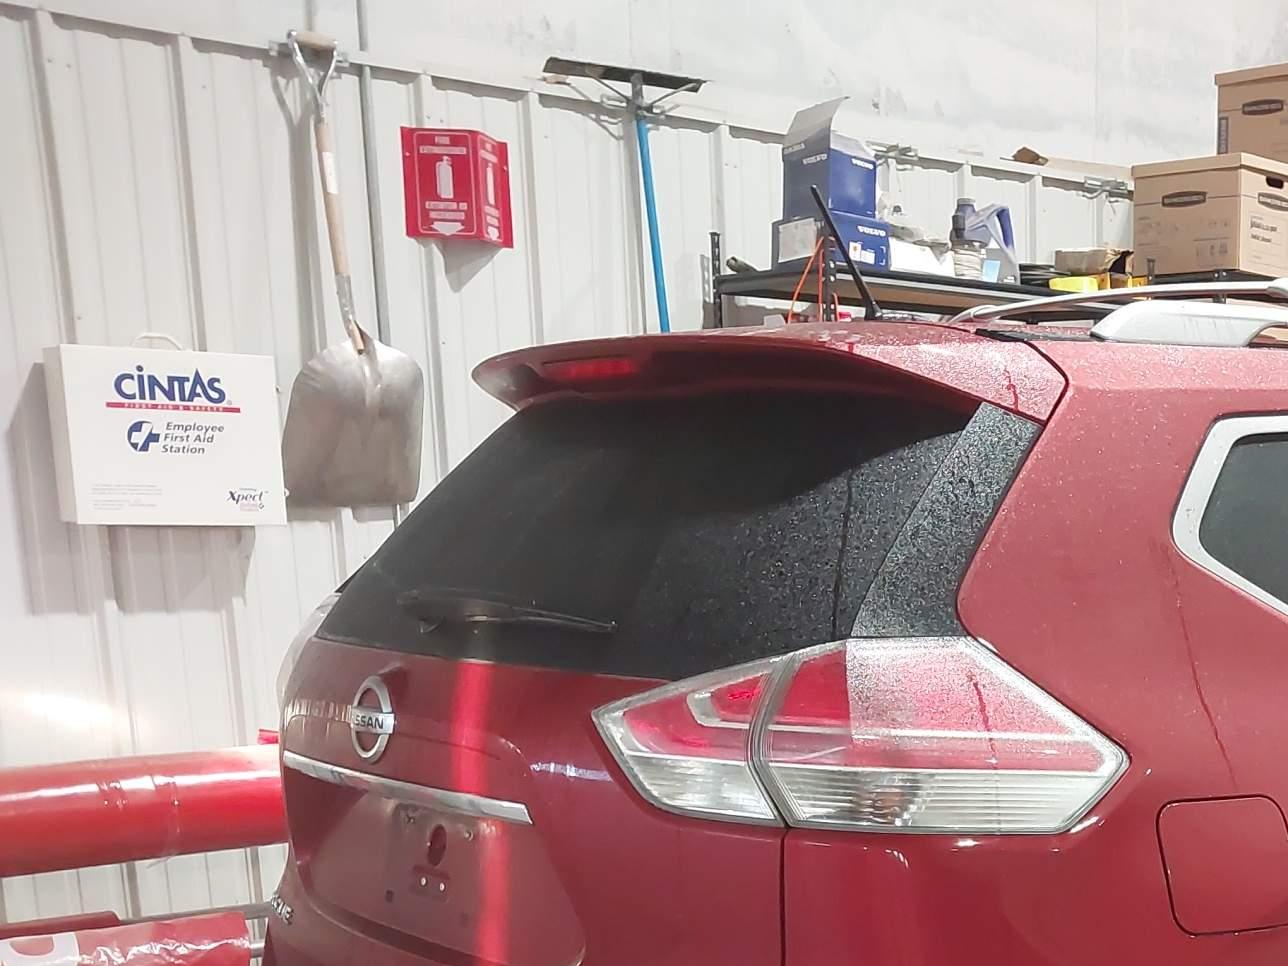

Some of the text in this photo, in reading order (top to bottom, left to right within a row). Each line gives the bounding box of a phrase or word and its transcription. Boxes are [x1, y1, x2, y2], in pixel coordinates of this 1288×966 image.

[858, 226, 886, 237] VOLVO
[166, 421, 225, 433] Employee
[163, 433, 215, 443] First Aid
[161, 444, 205, 454] Station
